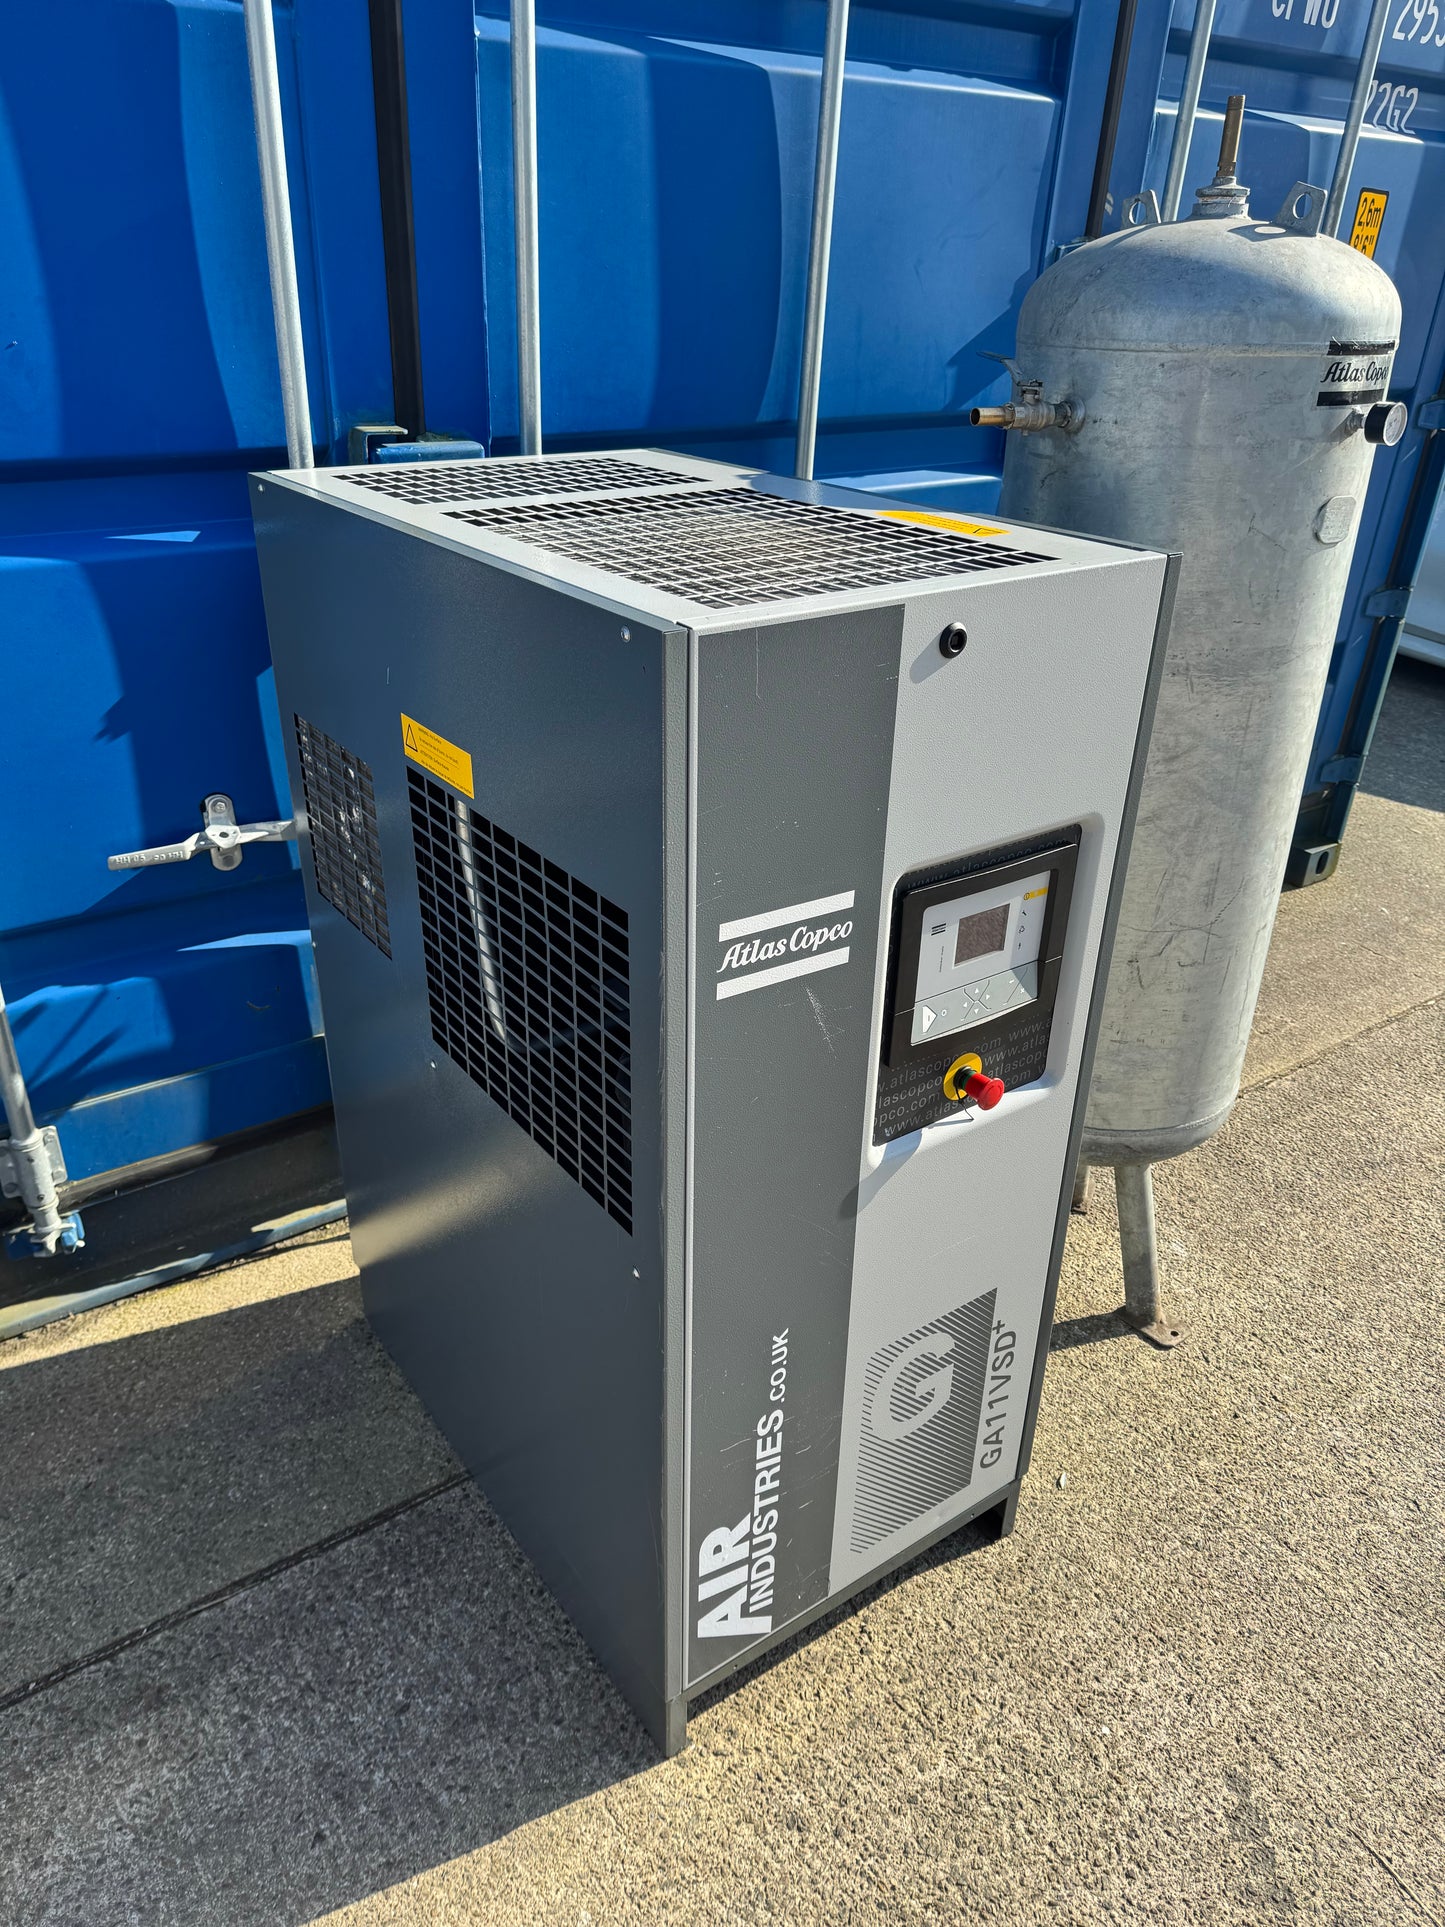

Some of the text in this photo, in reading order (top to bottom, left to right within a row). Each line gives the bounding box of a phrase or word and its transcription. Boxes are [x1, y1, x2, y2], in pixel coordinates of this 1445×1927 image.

[1357, 197, 1381, 232] 2,6m
[1320, 361, 1366, 383] Atlas
[716, 921, 853, 973] Atlas Copco
[979, 1319, 1017, 1469] GA11VSD+
[697, 1512, 773, 1639] AIR
